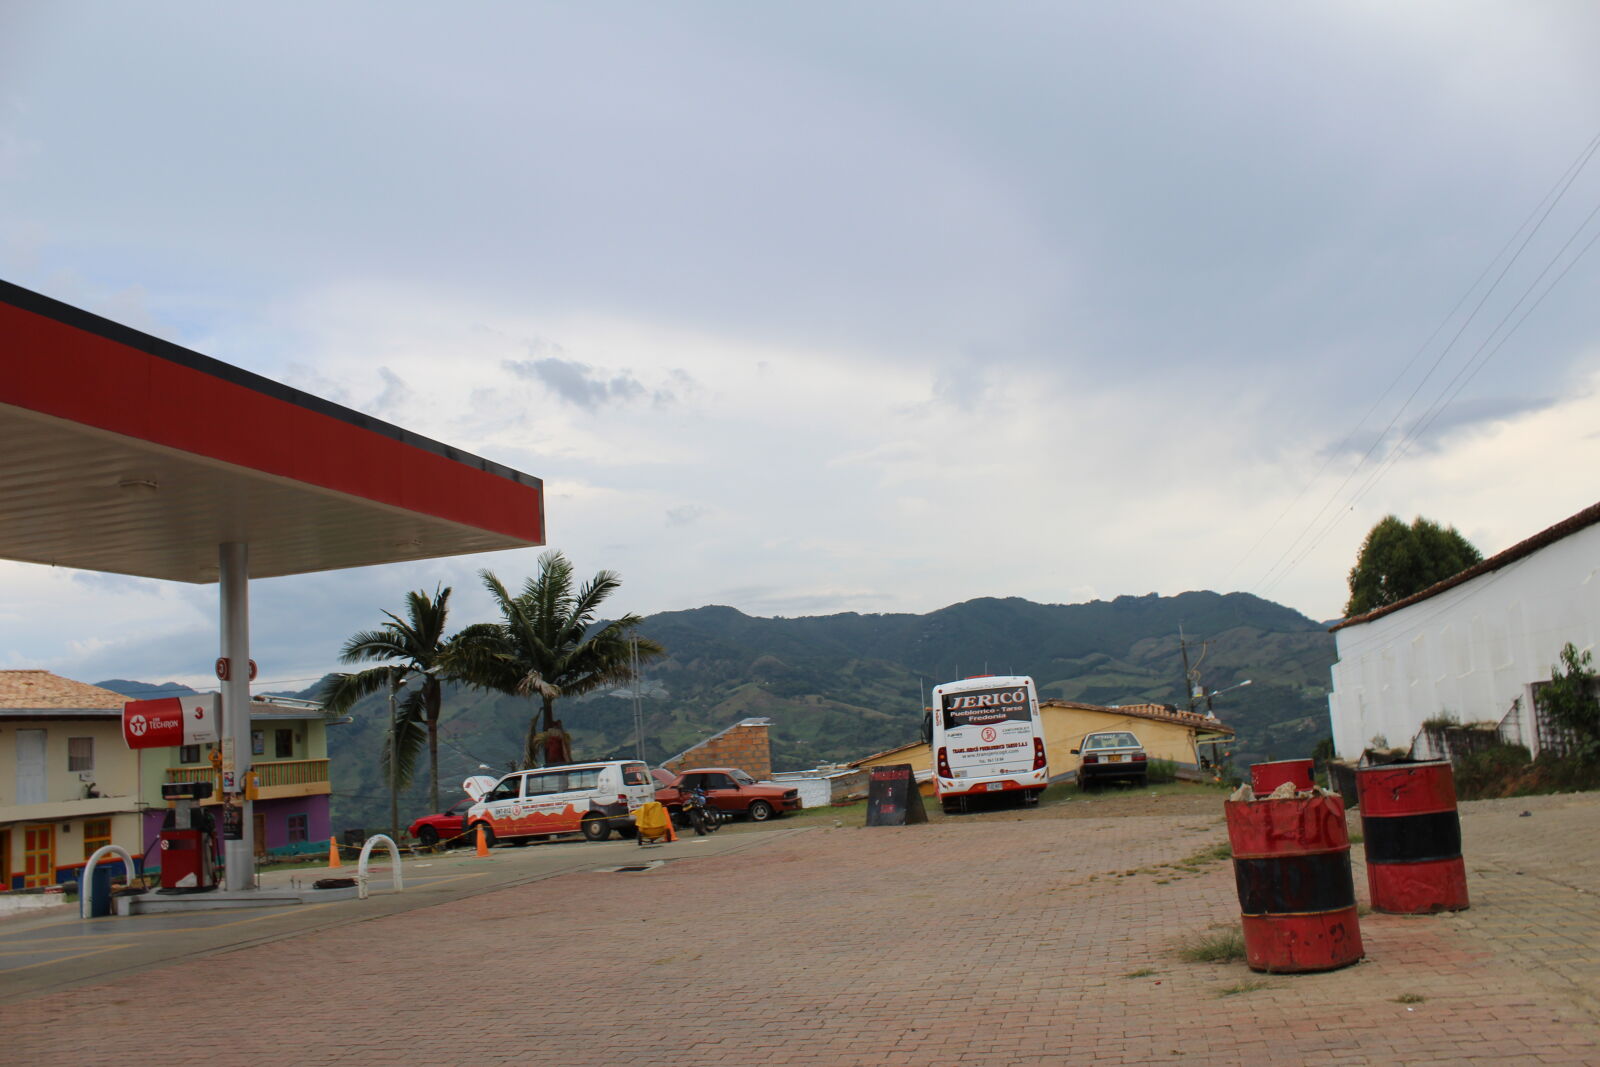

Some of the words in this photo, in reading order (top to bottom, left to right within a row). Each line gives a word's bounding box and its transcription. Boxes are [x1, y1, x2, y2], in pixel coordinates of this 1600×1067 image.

[946, 688, 1026, 710] JERICÓ
[194, 706, 204, 720] 3
[950, 708, 997, 717] Pueblorrico
[968, 713, 1007, 721] Fredonia
[149, 719, 179, 730] TECHRON
